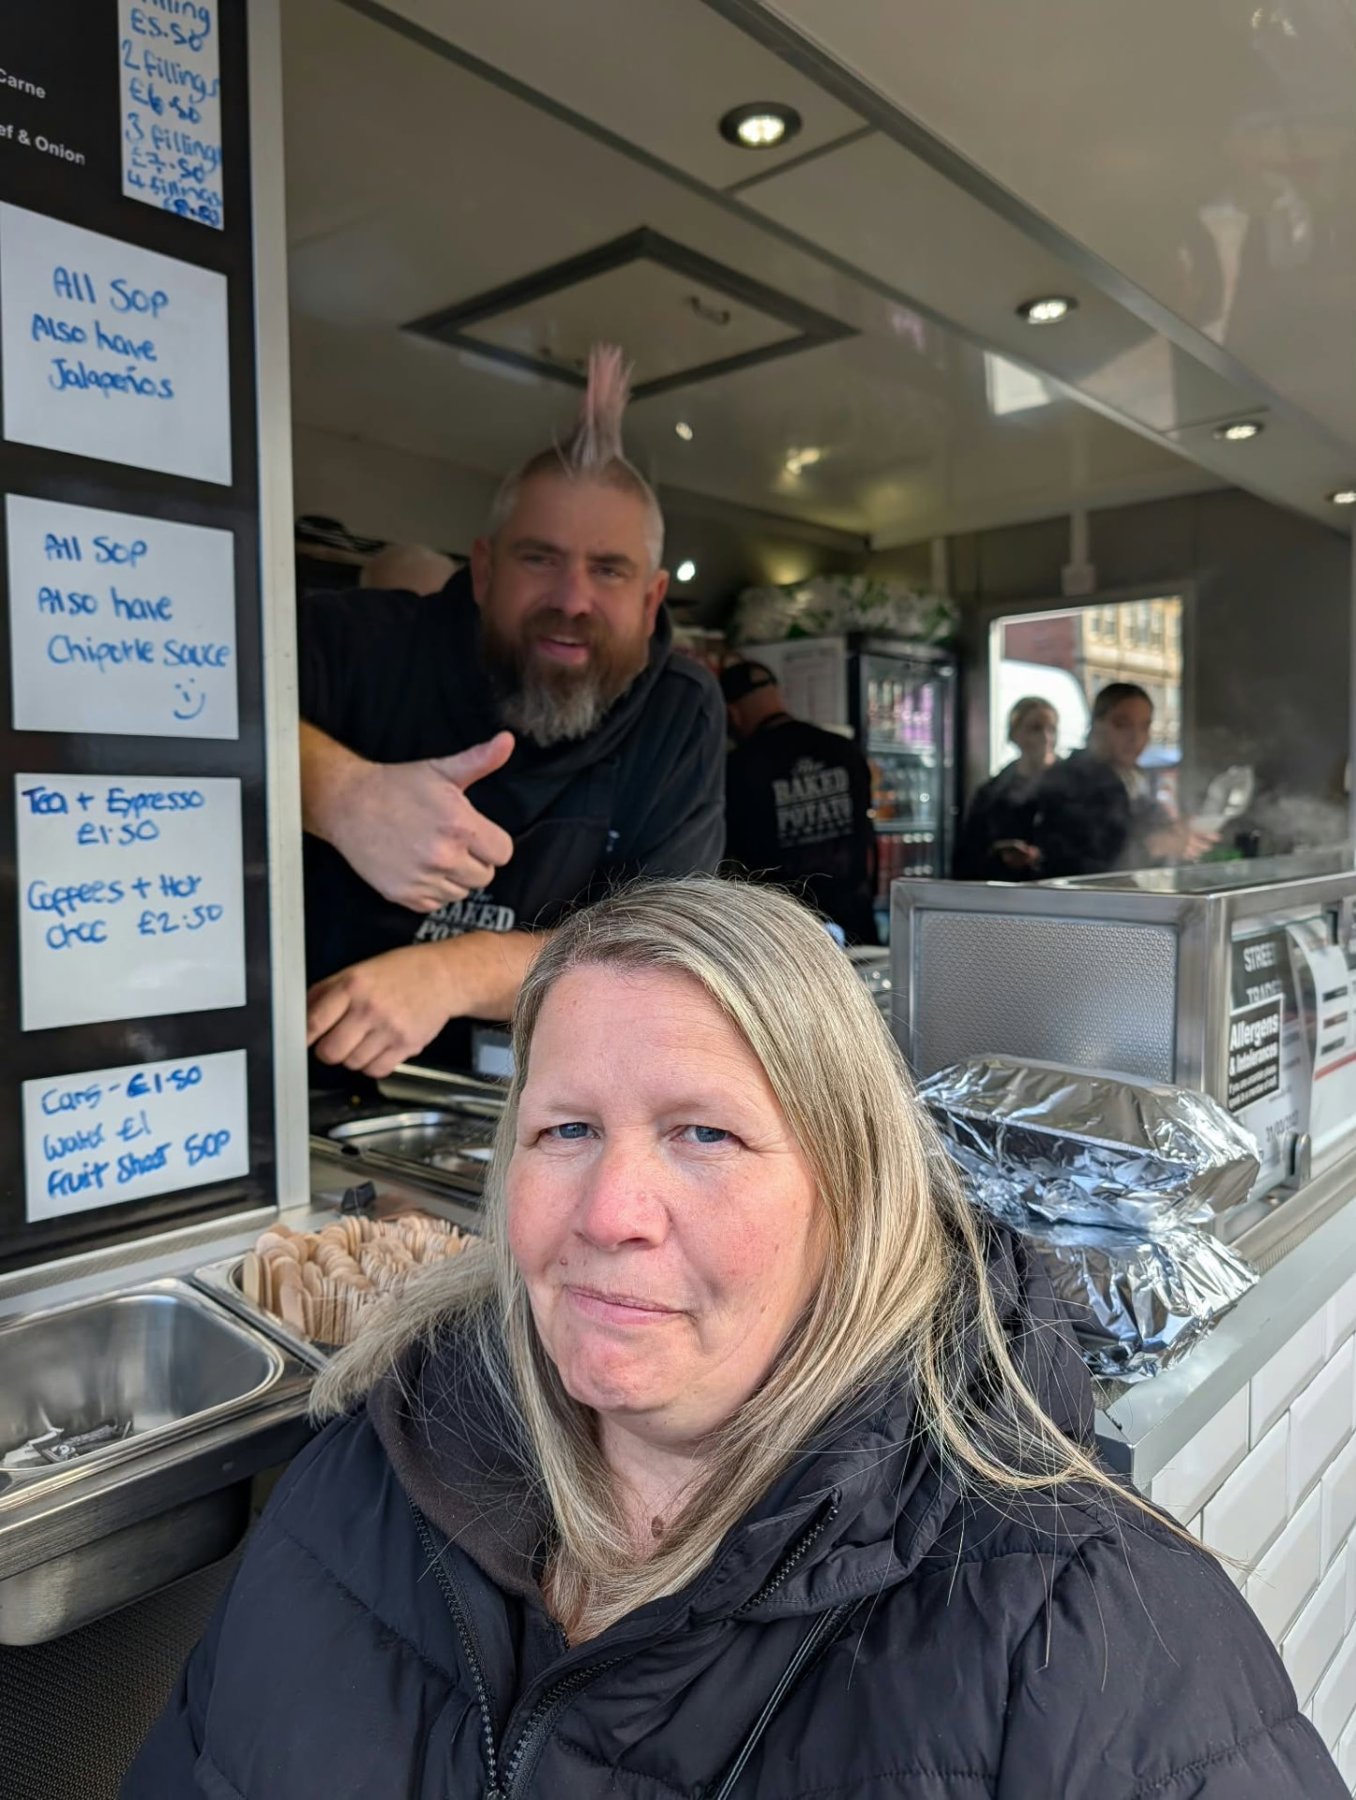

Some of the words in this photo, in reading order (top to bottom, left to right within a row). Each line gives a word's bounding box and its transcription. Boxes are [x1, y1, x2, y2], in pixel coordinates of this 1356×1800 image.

[122, 40, 140, 71] 2
[125, 113, 144, 143] 3
[17, 129, 31, 146] &
[34, 135, 86, 166] Onion
[127, 170, 146, 188] 4
[53, 266, 96, 304] All
[31, 313, 87, 342] Also
[95, 320, 157, 362] have
[48, 357, 174, 399] Jalapeños
[45, 533, 82, 561] All
[38, 586, 97, 615] Also
[110, 586, 173, 620] have
[22, 786, 68, 815] Tea
[77, 793, 95, 811] +
[772, 766, 850, 804] BAKED
[27, 880, 124, 917] Coffees
[131, 877, 152, 899] +
[160, 873, 202, 898] Hot
[137, 904, 223, 936] £2.50
[1230, 1013, 1280, 1051] Allergens
[116, 1110, 152, 1142] £1
[47, 1161, 110, 1198] Fruit
